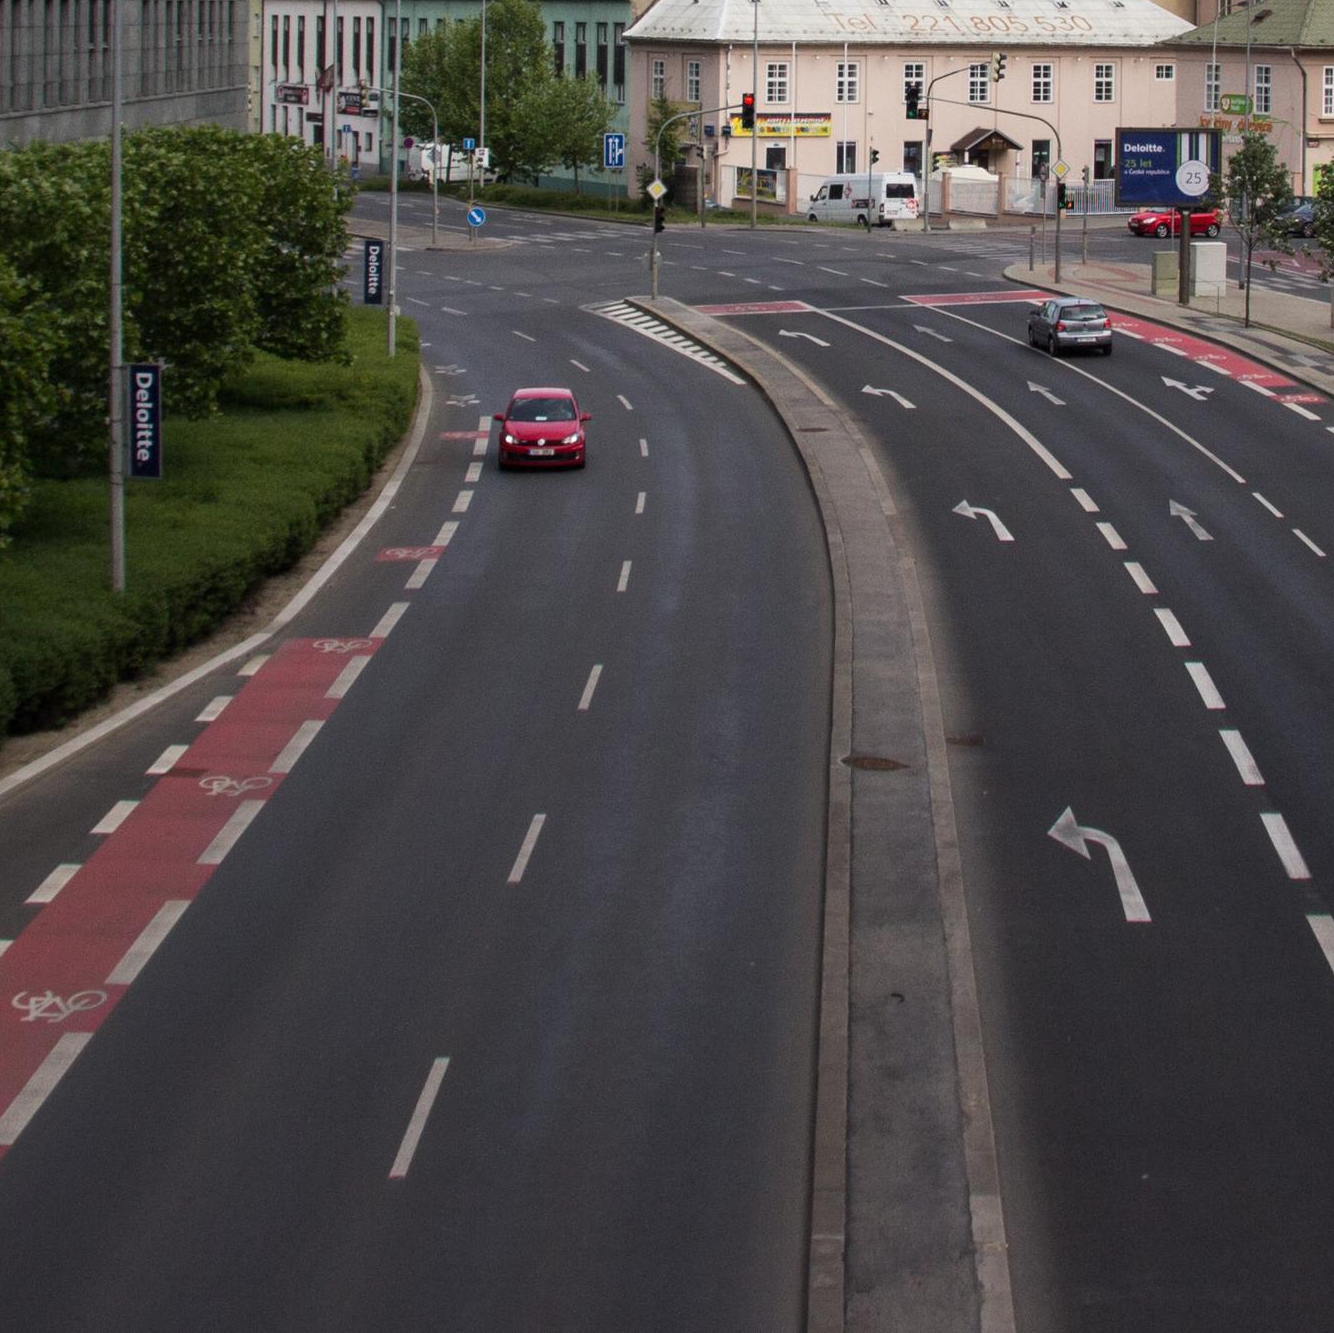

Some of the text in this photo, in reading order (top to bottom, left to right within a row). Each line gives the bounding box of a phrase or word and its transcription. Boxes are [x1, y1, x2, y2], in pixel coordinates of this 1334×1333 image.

[902, 14, 963, 32] 221
[970, 15, 1029, 33] 805
[1033, 15, 1093, 33] 530
[1125, 158, 1153, 168] 25 let
[1186, 172, 1202, 185] 25
